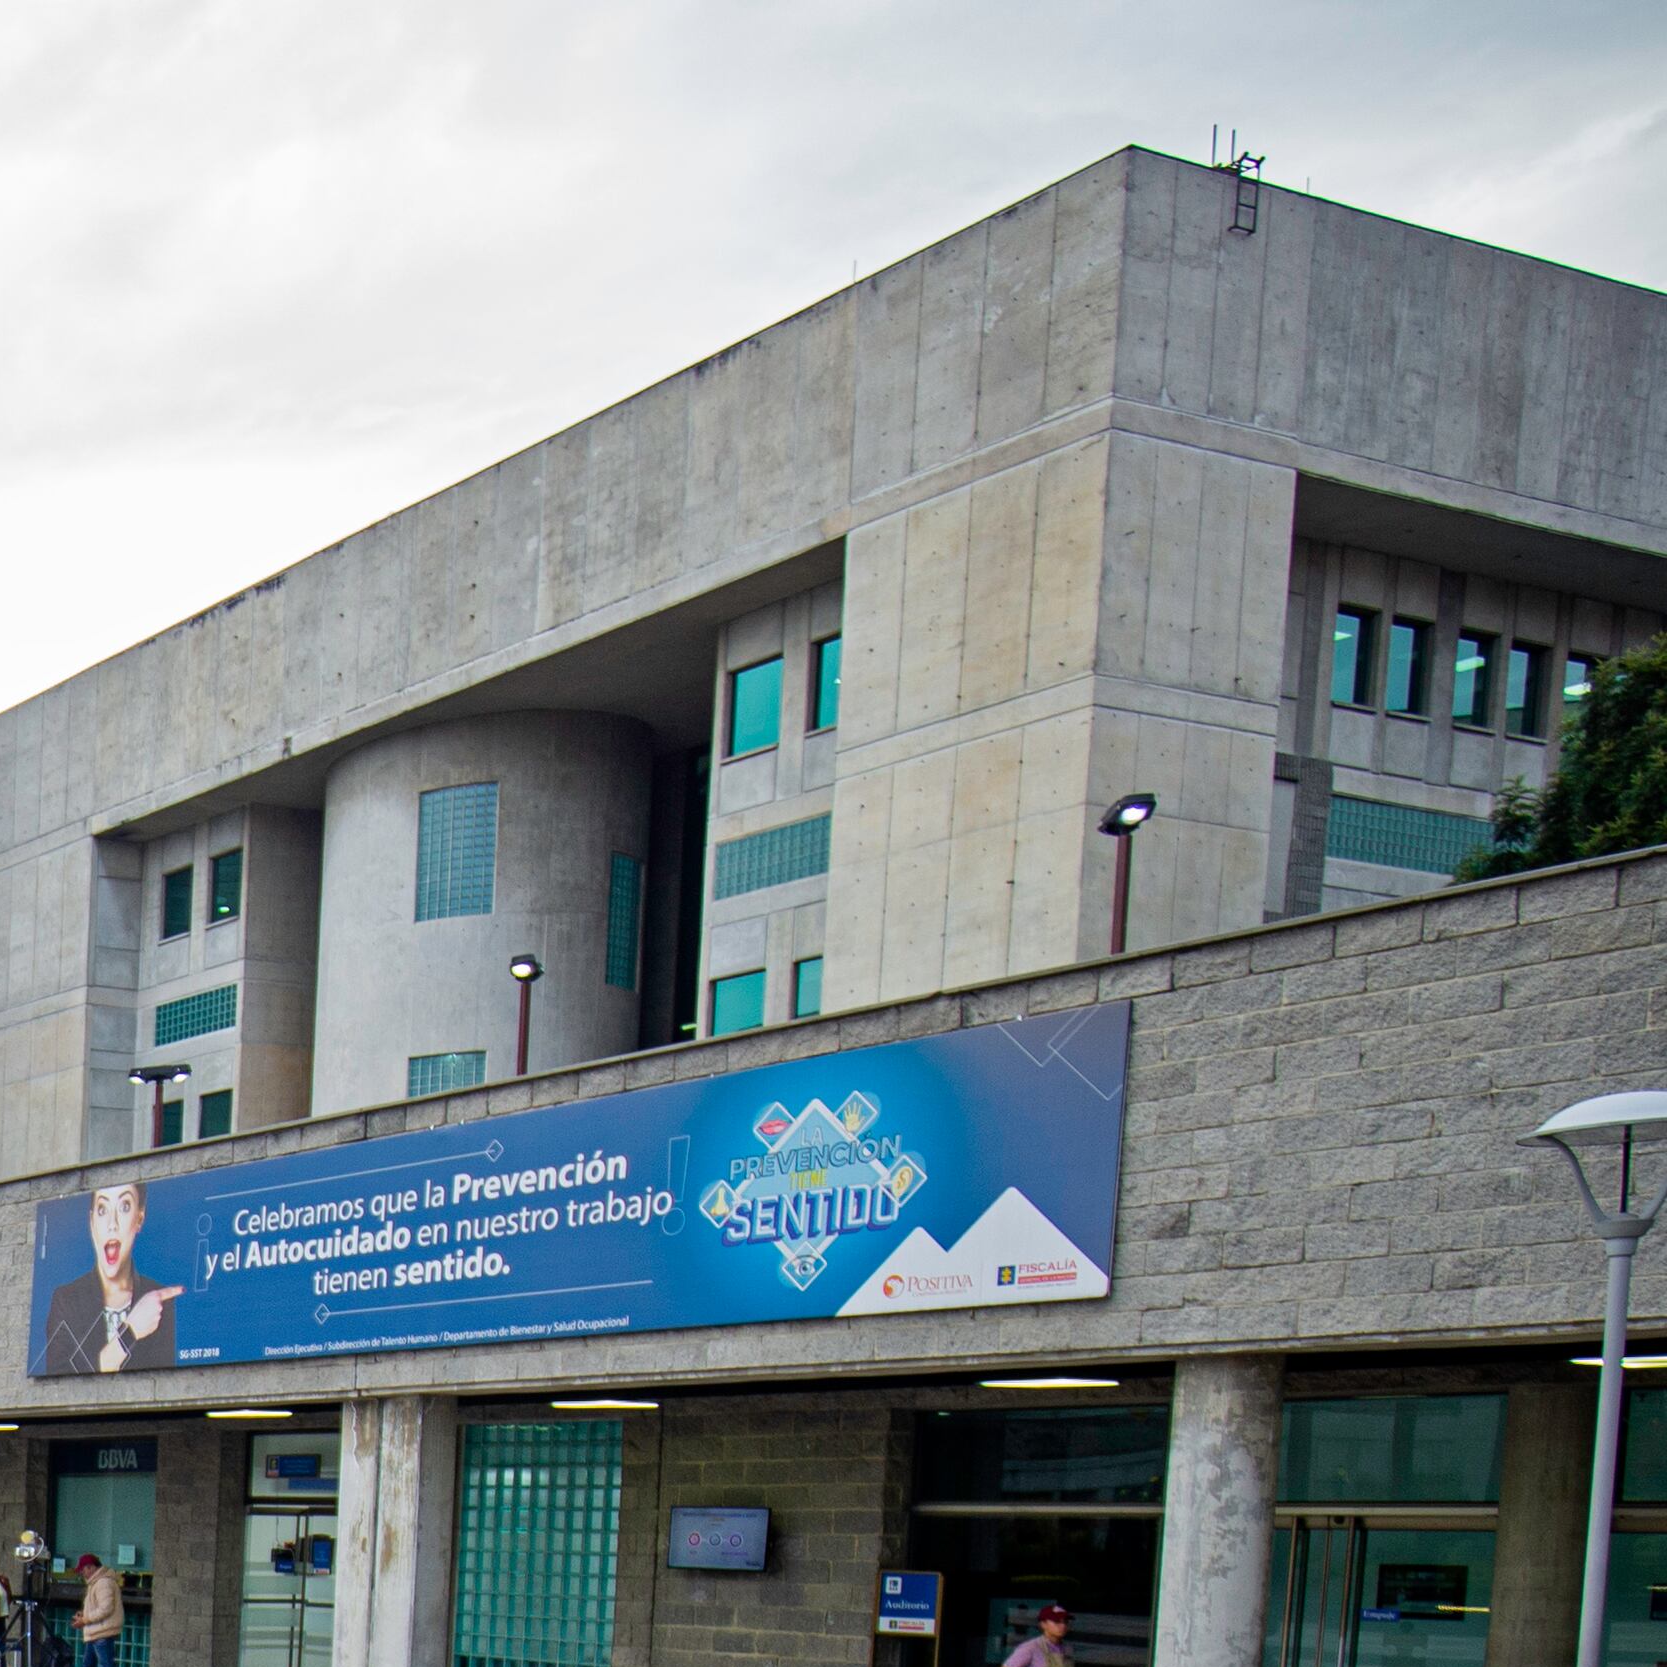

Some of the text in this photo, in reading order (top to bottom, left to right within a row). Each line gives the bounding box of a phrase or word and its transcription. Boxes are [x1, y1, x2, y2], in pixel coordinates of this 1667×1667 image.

[801, 1127, 824, 1146] LA
[729, 1132, 902, 1181] PREVENCIÓN
[234, 1150, 628, 1237] Celebramos que la Prevención
[789, 1167, 828, 1190] TIENE
[722, 1181, 900, 1246] SENTIDO
[205, 1186, 673, 1280] y el Autocuidado en nuestro trabajo
[314, 1246, 511, 1296] tienen sentido.
[908, 1274, 973, 1292] POSITIVA
[328, 1338, 371, 1351] Subdirección
[371, 1336, 381, 1347] de
[382, 1335, 407, 1346] Talento
[408, 1333, 438, 1344] Humano
[444, 1328, 498, 1342] Departamento
[499, 1326, 509, 1337] de
[510, 1324, 546, 1336] Bienestar
[553, 1320, 576, 1333] Salud
[577, 1315, 630, 1331] Ocupacional
[98, 1448, 138, 1470] BBVA
[886, 1599, 930, 1612] Auditorio
